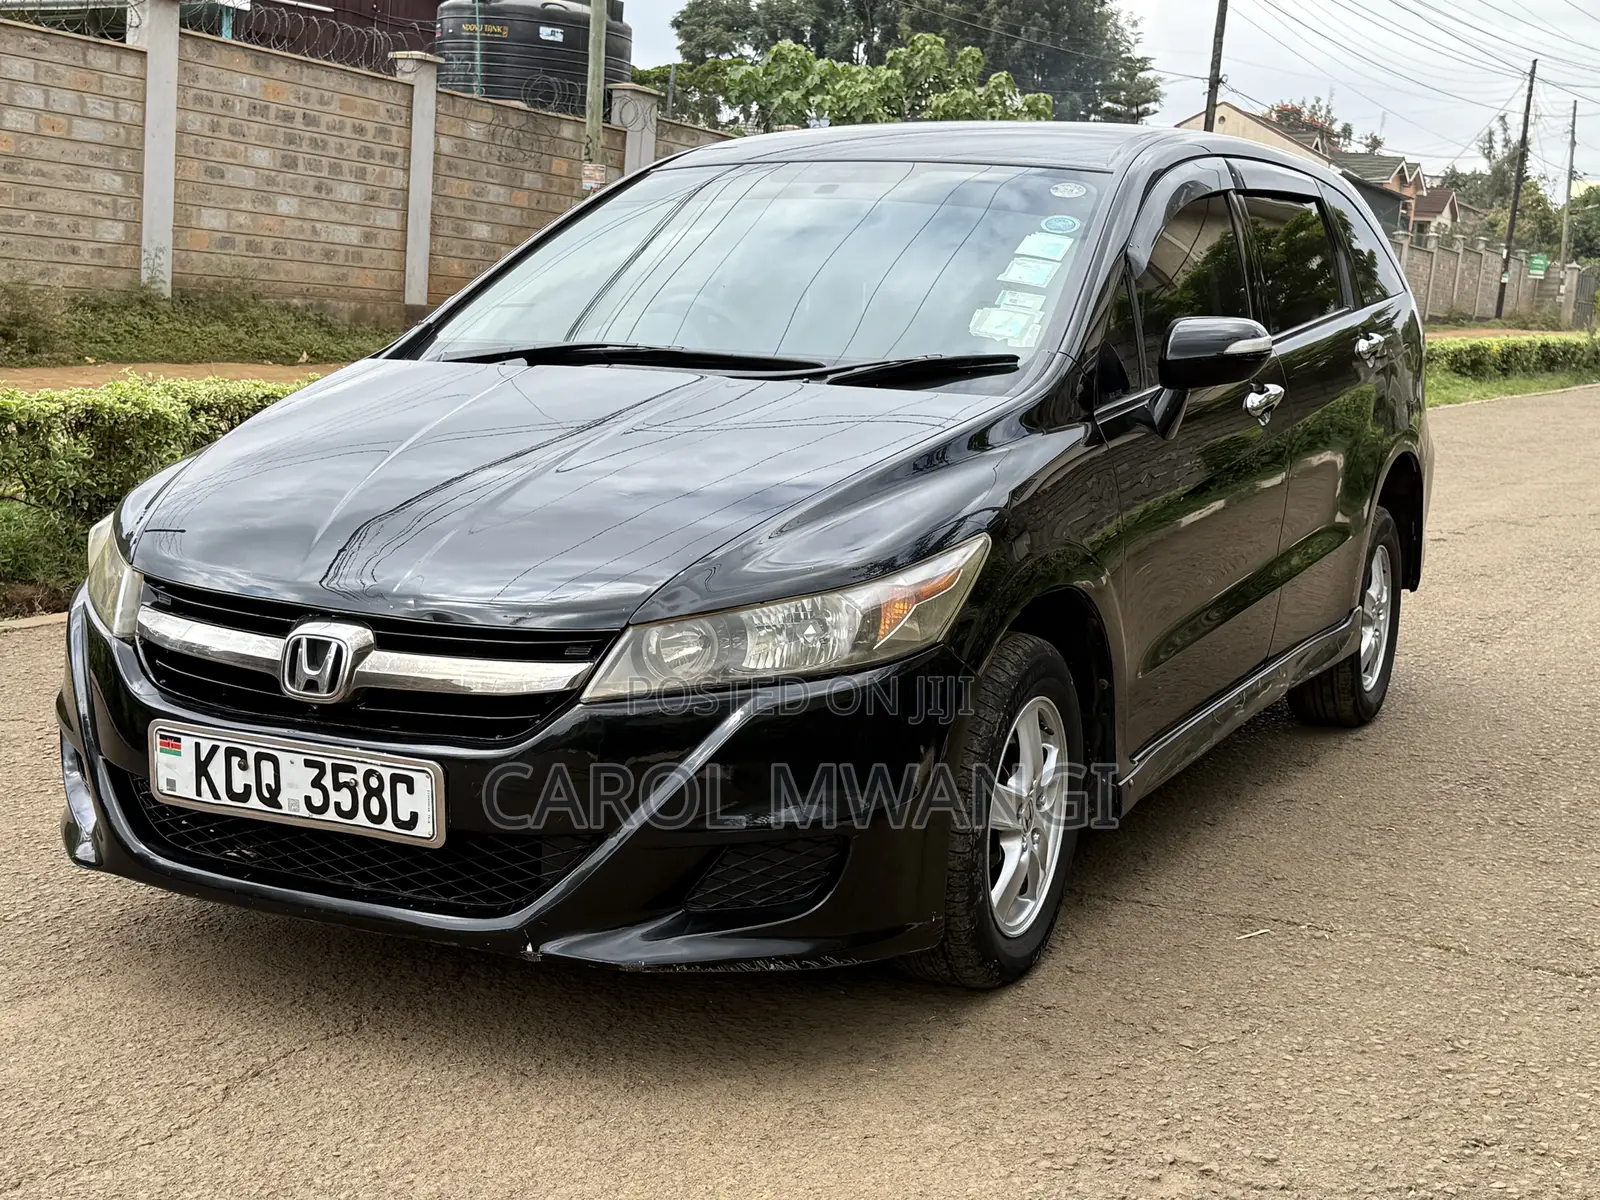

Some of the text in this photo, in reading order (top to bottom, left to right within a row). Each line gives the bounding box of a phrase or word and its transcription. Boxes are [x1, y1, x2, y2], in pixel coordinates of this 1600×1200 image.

[484, 24, 503, 33] TANK
[194, 741, 283, 810] KCQ
[303, 757, 419, 831] 358C
